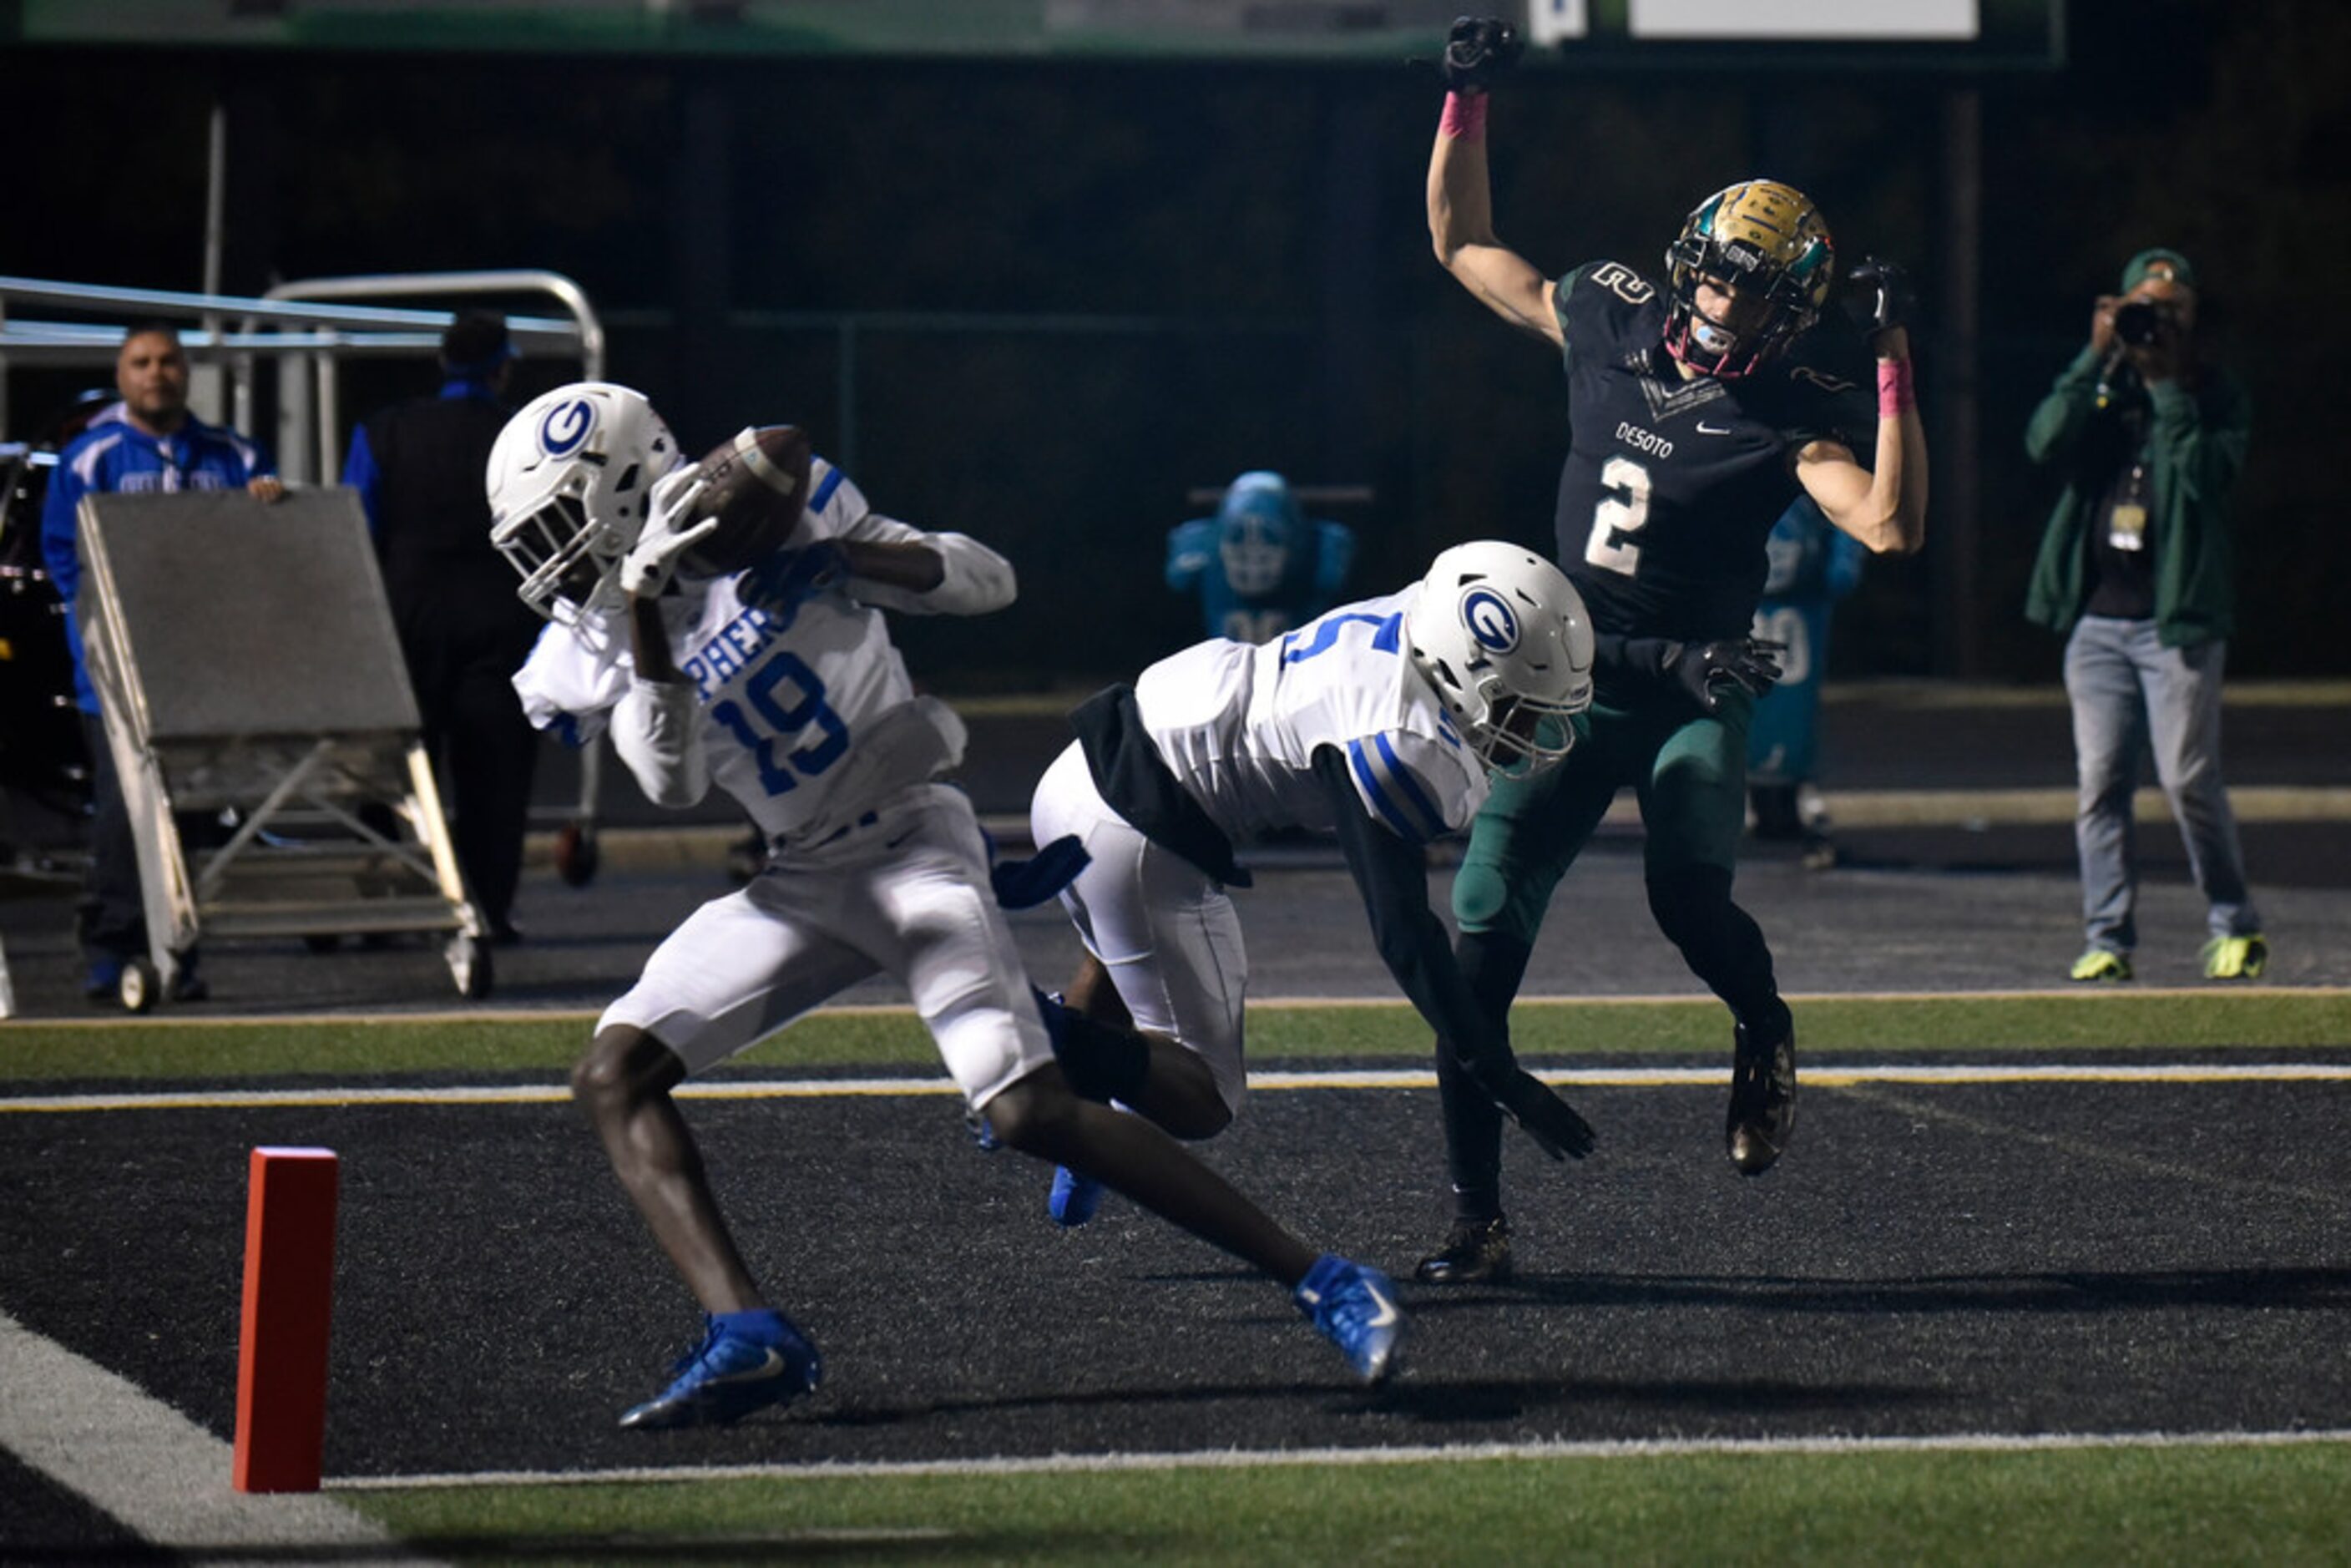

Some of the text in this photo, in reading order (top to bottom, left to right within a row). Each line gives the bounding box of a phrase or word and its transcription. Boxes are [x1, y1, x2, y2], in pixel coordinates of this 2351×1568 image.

[1590, 261, 1655, 304] 2
[544, 399, 592, 455] G
[1615, 422, 1674, 459] DESOTO
[1585, 458, 1652, 576] 2
[1464, 592, 1517, 650] G
[711, 651, 850, 797] 19
